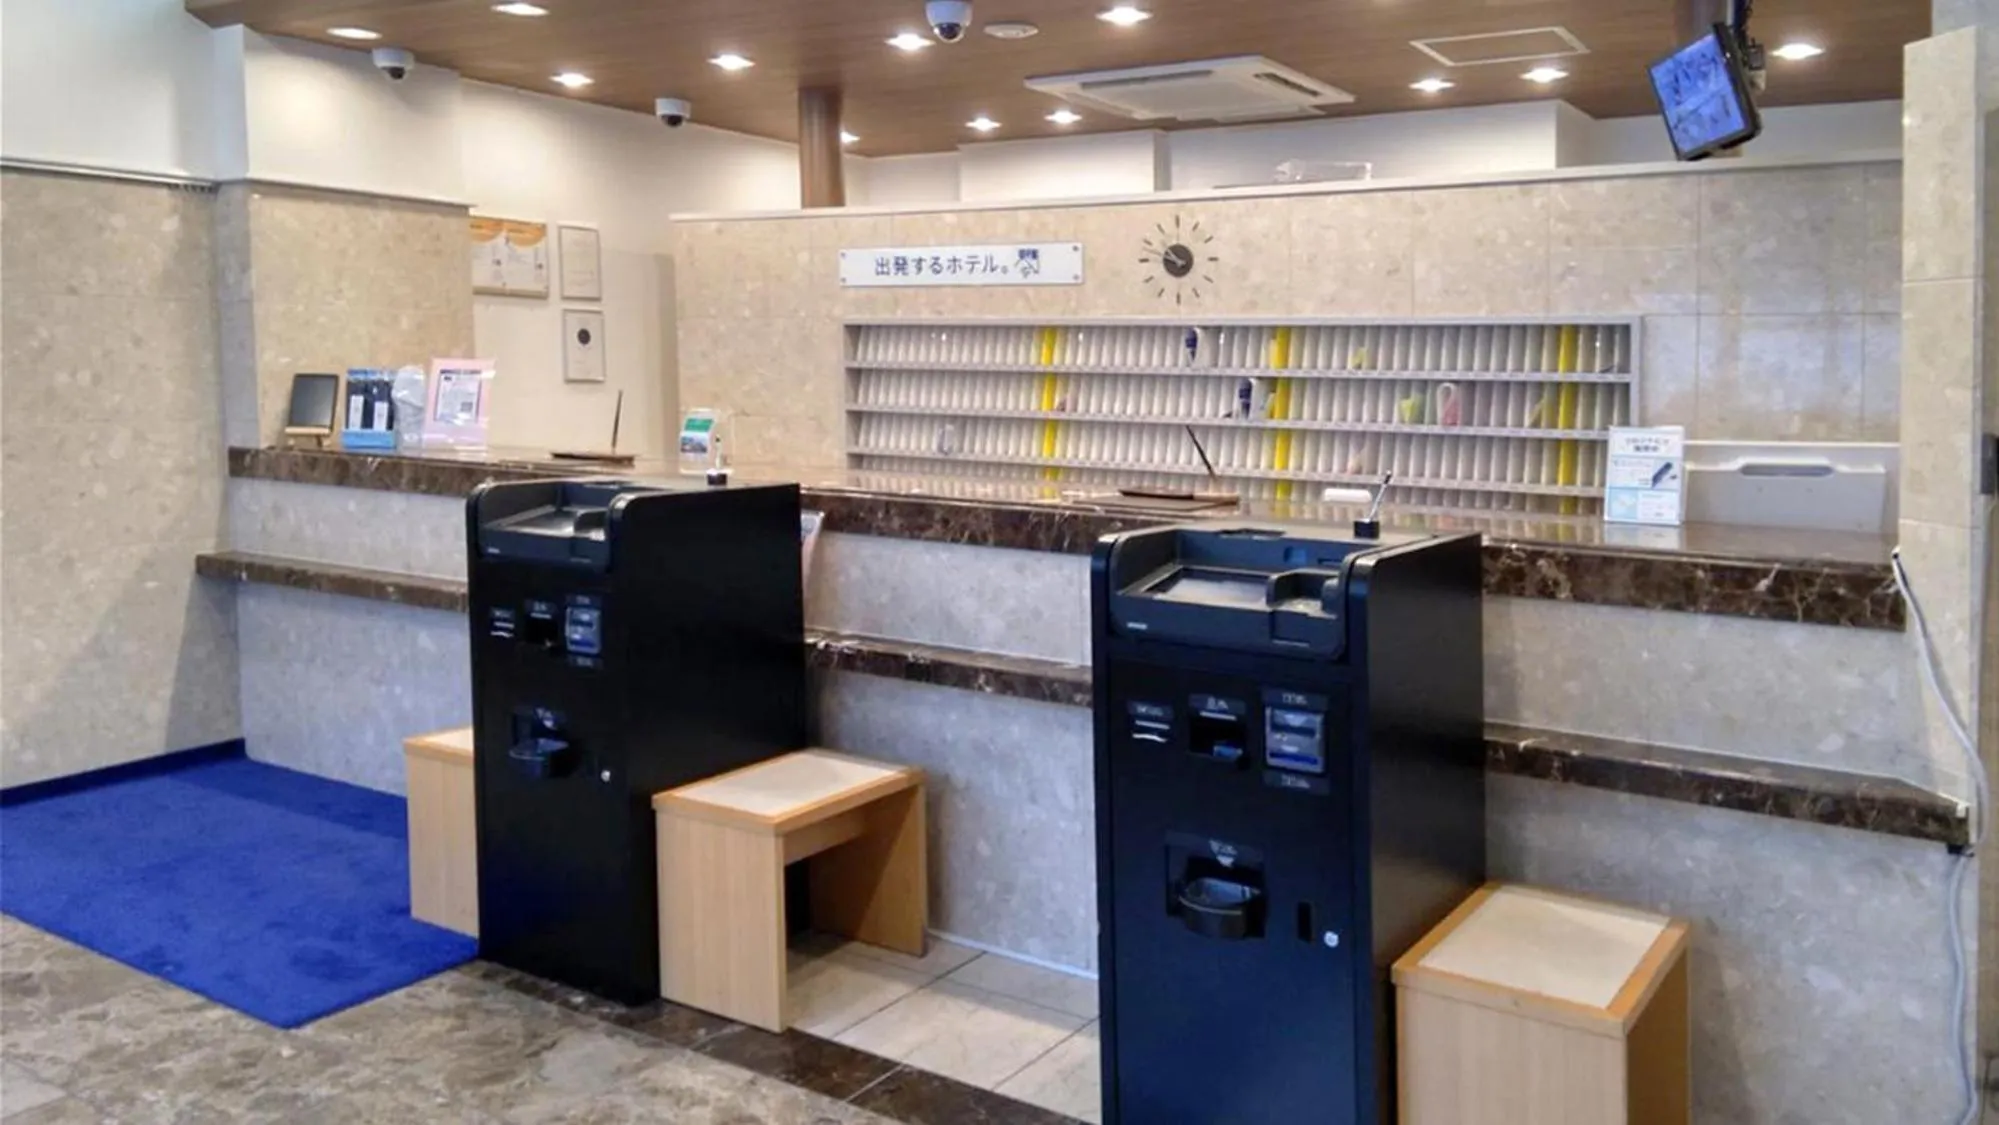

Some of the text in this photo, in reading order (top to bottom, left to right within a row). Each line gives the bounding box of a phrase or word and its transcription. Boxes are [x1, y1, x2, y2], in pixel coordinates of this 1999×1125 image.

[875, 253, 1009, 276] 出発するホテル。
